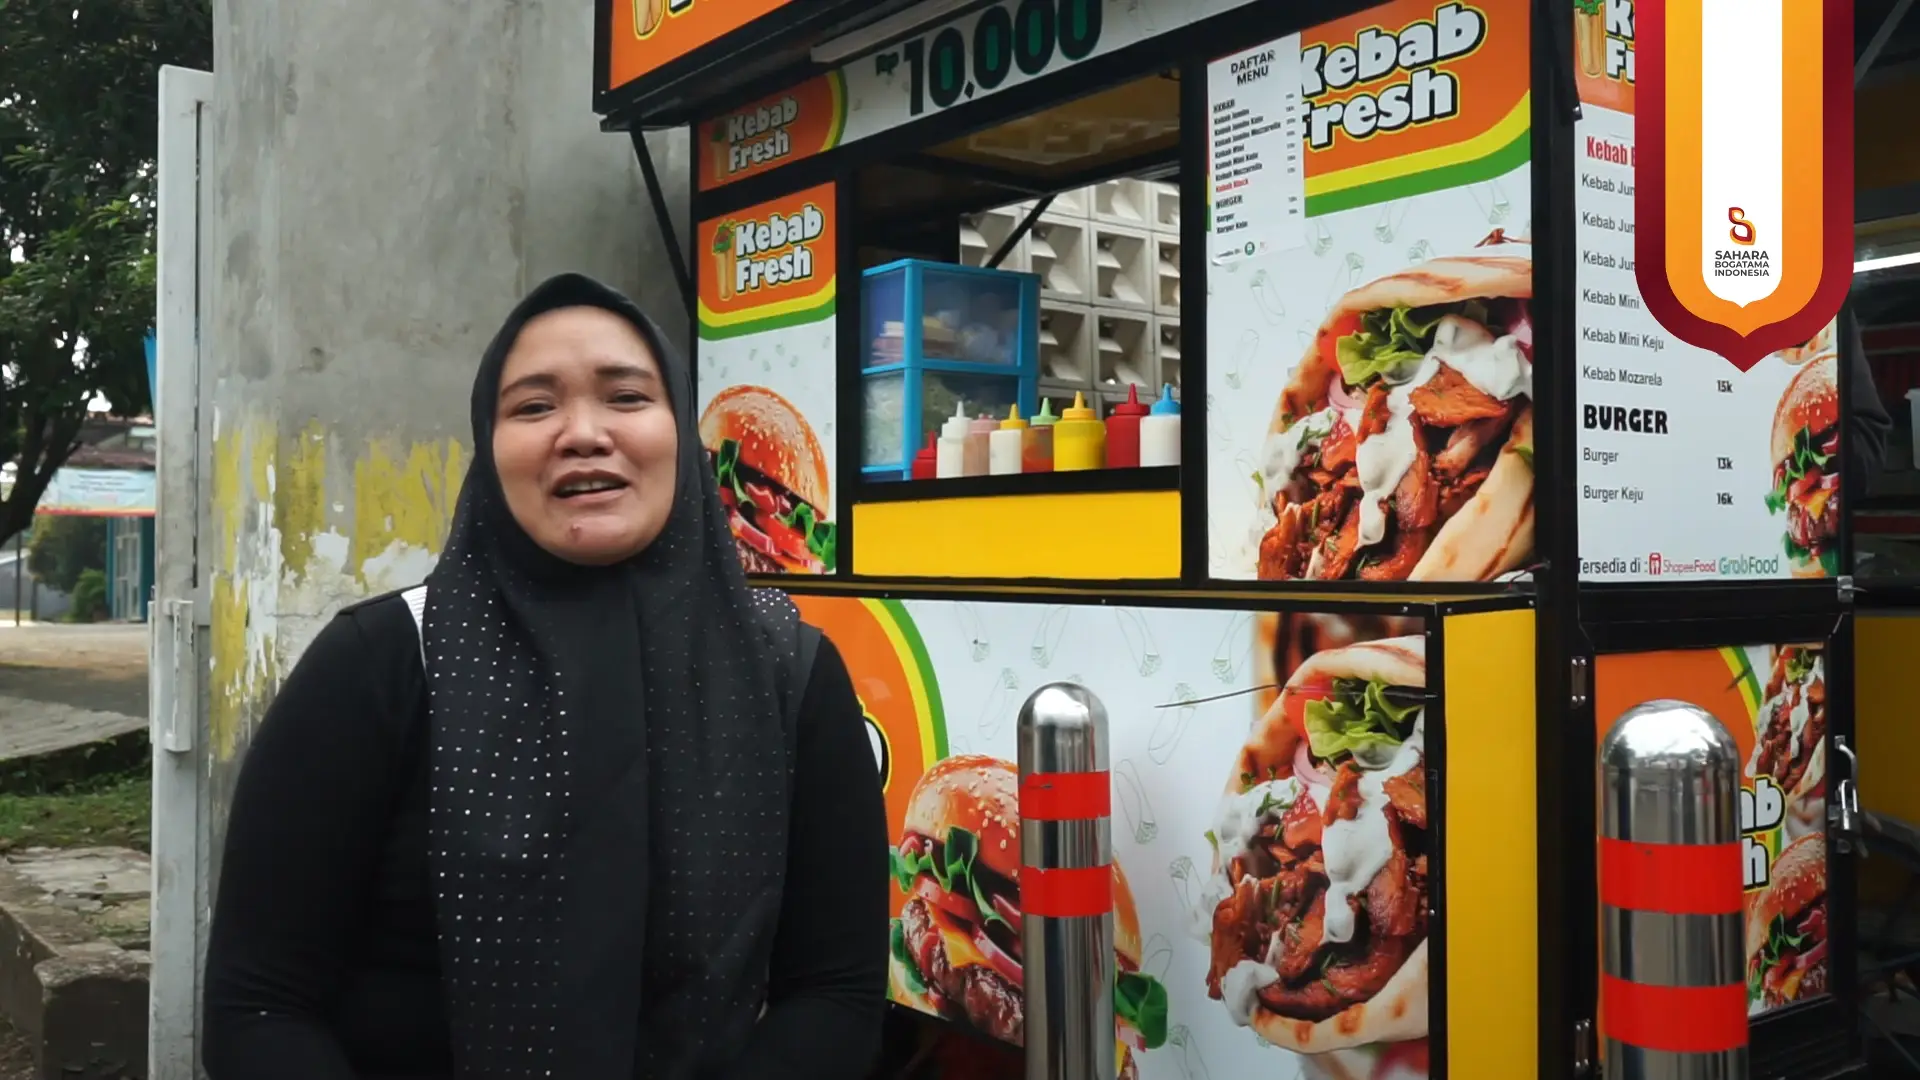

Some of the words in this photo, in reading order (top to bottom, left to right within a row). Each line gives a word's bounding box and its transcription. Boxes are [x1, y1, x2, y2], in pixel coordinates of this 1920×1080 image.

[1230, 49, 1276, 75] DAFTAR
[1236, 65, 1269, 86] MENU
[728, 96, 798, 143] Kebab
[728, 130, 790, 174] Fresh
[1586, 135, 1628, 165] Kebab
[1582, 173, 1615, 193] Kebab
[735, 205, 824, 257] Kebab
[1582, 212, 1616, 230] Kebab
[736, 245, 813, 293] Fresh
[1583, 250, 1616, 268] Kebab
[1583, 288, 1616, 306] Kebab
[1619, 293, 1640, 309] Mini
[1582, 327, 1616, 344] Kebab
[1618, 331, 1640, 347] Mini
[1642, 335, 1665, 352] Keju
[1582, 365, 1616, 382] Kebab
[1618, 369, 1663, 386] Mozarela
[1716, 380, 1733, 393] 15k
[1583, 404, 1669, 434] BURGER
[1583, 447, 1619, 465] Burger
[1716, 457, 1733, 470] 13k
[1583, 485, 1618, 503] Burger
[1621, 486, 1644, 503] Keju
[1716, 493, 1733, 505] 16k
[1663, 559, 1716, 576] ShopeeFood
[1718, 554, 1779, 575] GrabFood
